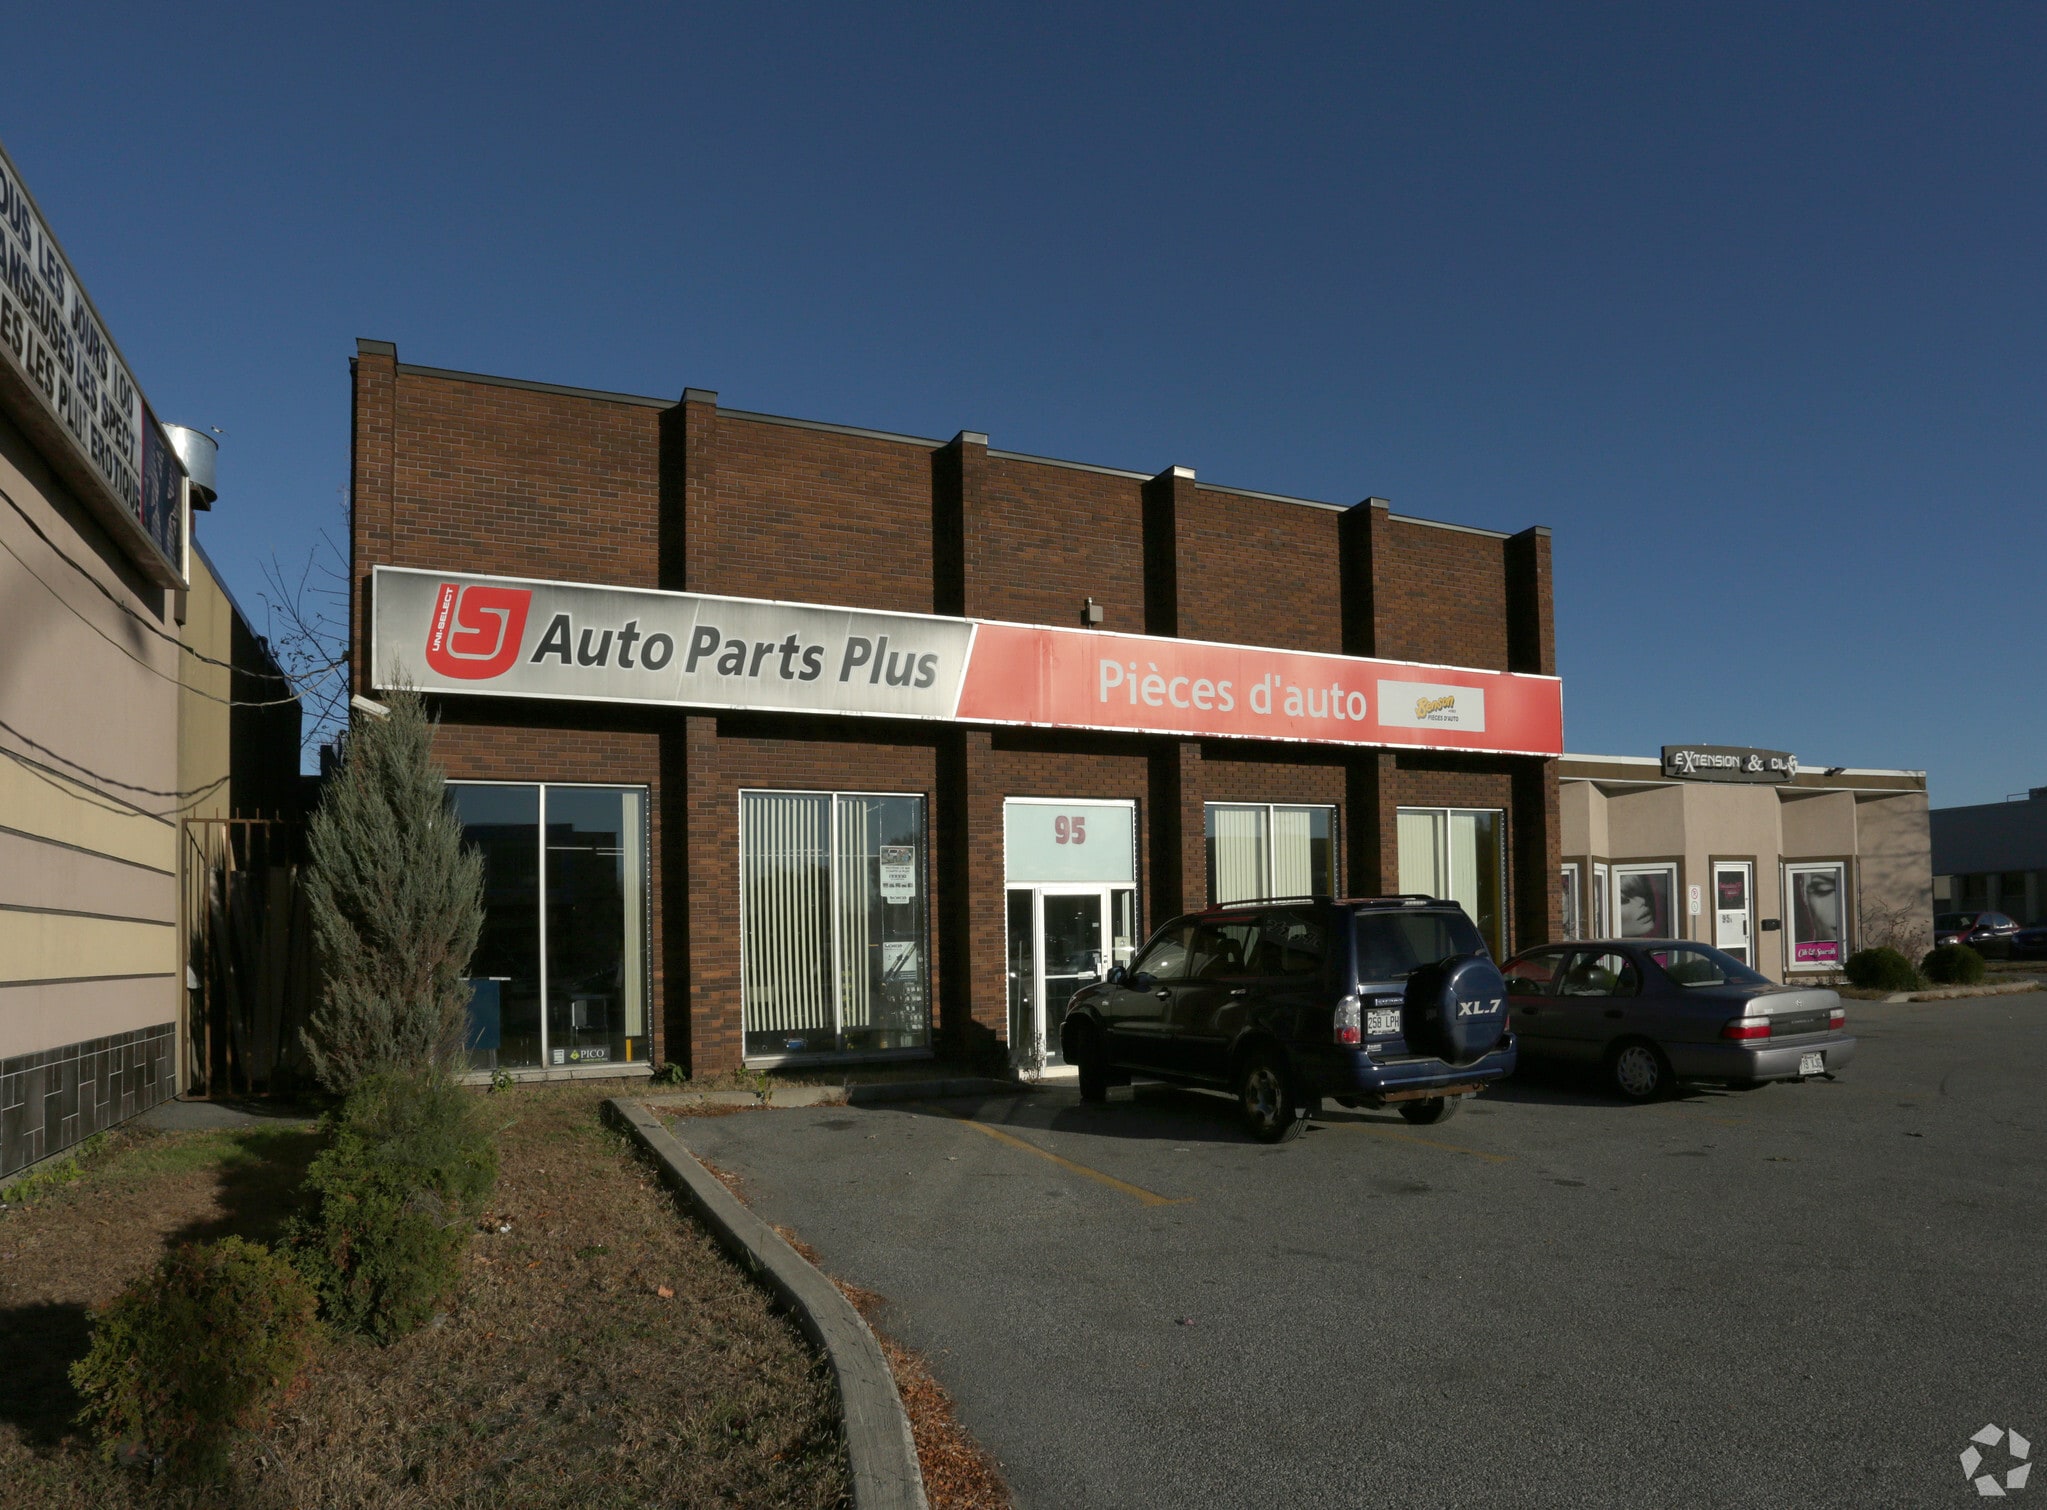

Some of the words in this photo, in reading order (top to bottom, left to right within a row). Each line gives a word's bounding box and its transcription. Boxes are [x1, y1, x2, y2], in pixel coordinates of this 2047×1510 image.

[38, 231, 65, 307] LES
[71, 295, 107, 382] JOURS
[113, 363, 133, 418] 100
[26, 336, 54, 401] LES
[76, 352, 97, 413] LES
[432, 587, 453, 651] UNI-SELECT
[529, 613, 674, 671] Auto
[684, 624, 825, 682] Parts
[838, 635, 939, 689] Plus
[1099, 659, 1235, 712] Pièces
[1249, 673, 1367, 721] d'auto
[1748, 754, 1764, 772] &
[1055, 815, 1086, 845] 95
[580, 1049, 605, 1059] PICO
